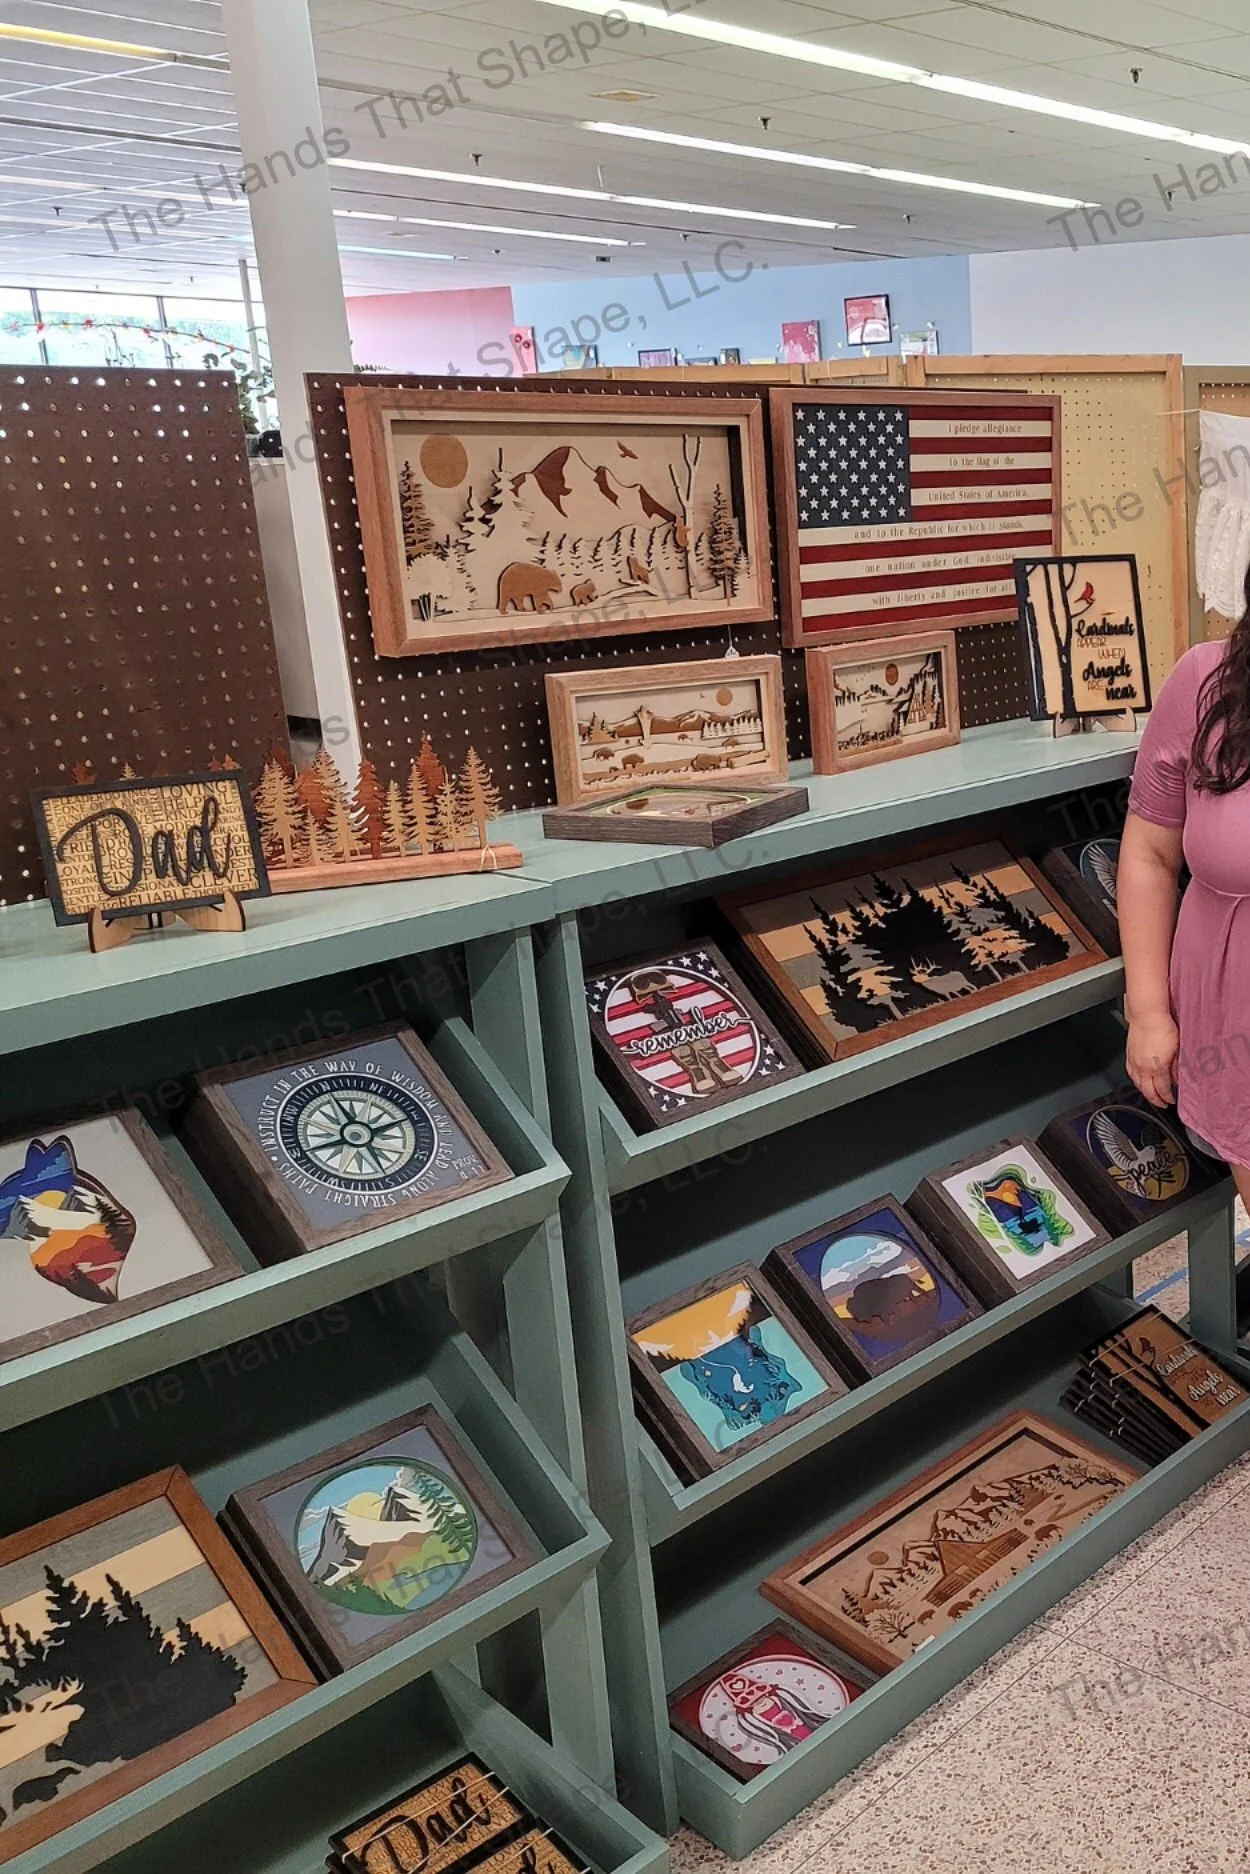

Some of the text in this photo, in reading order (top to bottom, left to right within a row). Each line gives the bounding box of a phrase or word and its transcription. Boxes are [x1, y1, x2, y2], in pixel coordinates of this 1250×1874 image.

[954, 423, 980, 435] pledge
[982, 423, 1023, 434] allegiance
[949, 455, 1016, 467] to the flag of the
[928, 490, 956, 501] United
[959, 489, 982, 500] States
[985, 488, 994, 498] of
[854, 529, 872, 540] and
[877, 528, 887, 538] to
[890, 526, 905, 537] the
[908, 523, 945, 537] Republic
[947, 522, 960, 533] for
[962, 521, 986, 532] which
[865, 562, 881, 573] one
[887, 559, 916, 572] nation
[921, 557, 947, 570] under
[872, 594, 891, 606] with
[896, 592, 926, 606] liberty
[930, 589, 946, 600] and
[952, 586, 980, 601] justice
[985, 585, 998, 594] for
[1075, 616, 1136, 638] Cardinals
[1076, 636, 1108, 648] APPEAR
[1097, 647, 1127, 660] WHEN
[1082, 656, 1133, 685] Angels
[1105, 683, 1138, 701] near
[161, 780, 228, 797] LOVING
[56, 795, 232, 898] Dad
[119, 887, 190, 906] RELIABLE
[627, 1006, 740, 1055] remember
[319, 1080, 332, 1092] N
[369, 1082, 387, 1096] NE
[256, 1061, 454, 1209] INSTRUCT IN THE WAY OF WISDOM AND LEAD ALONG STRAIGHT PATHS
[1128, 1151, 1175, 1197] peace
[1155, 1344, 1199, 1377] Cardinals
[1187, 1369, 1224, 1402] Angels
[1215, 1384, 1241, 1406] near
[360, 1777, 491, 1874] Dad
